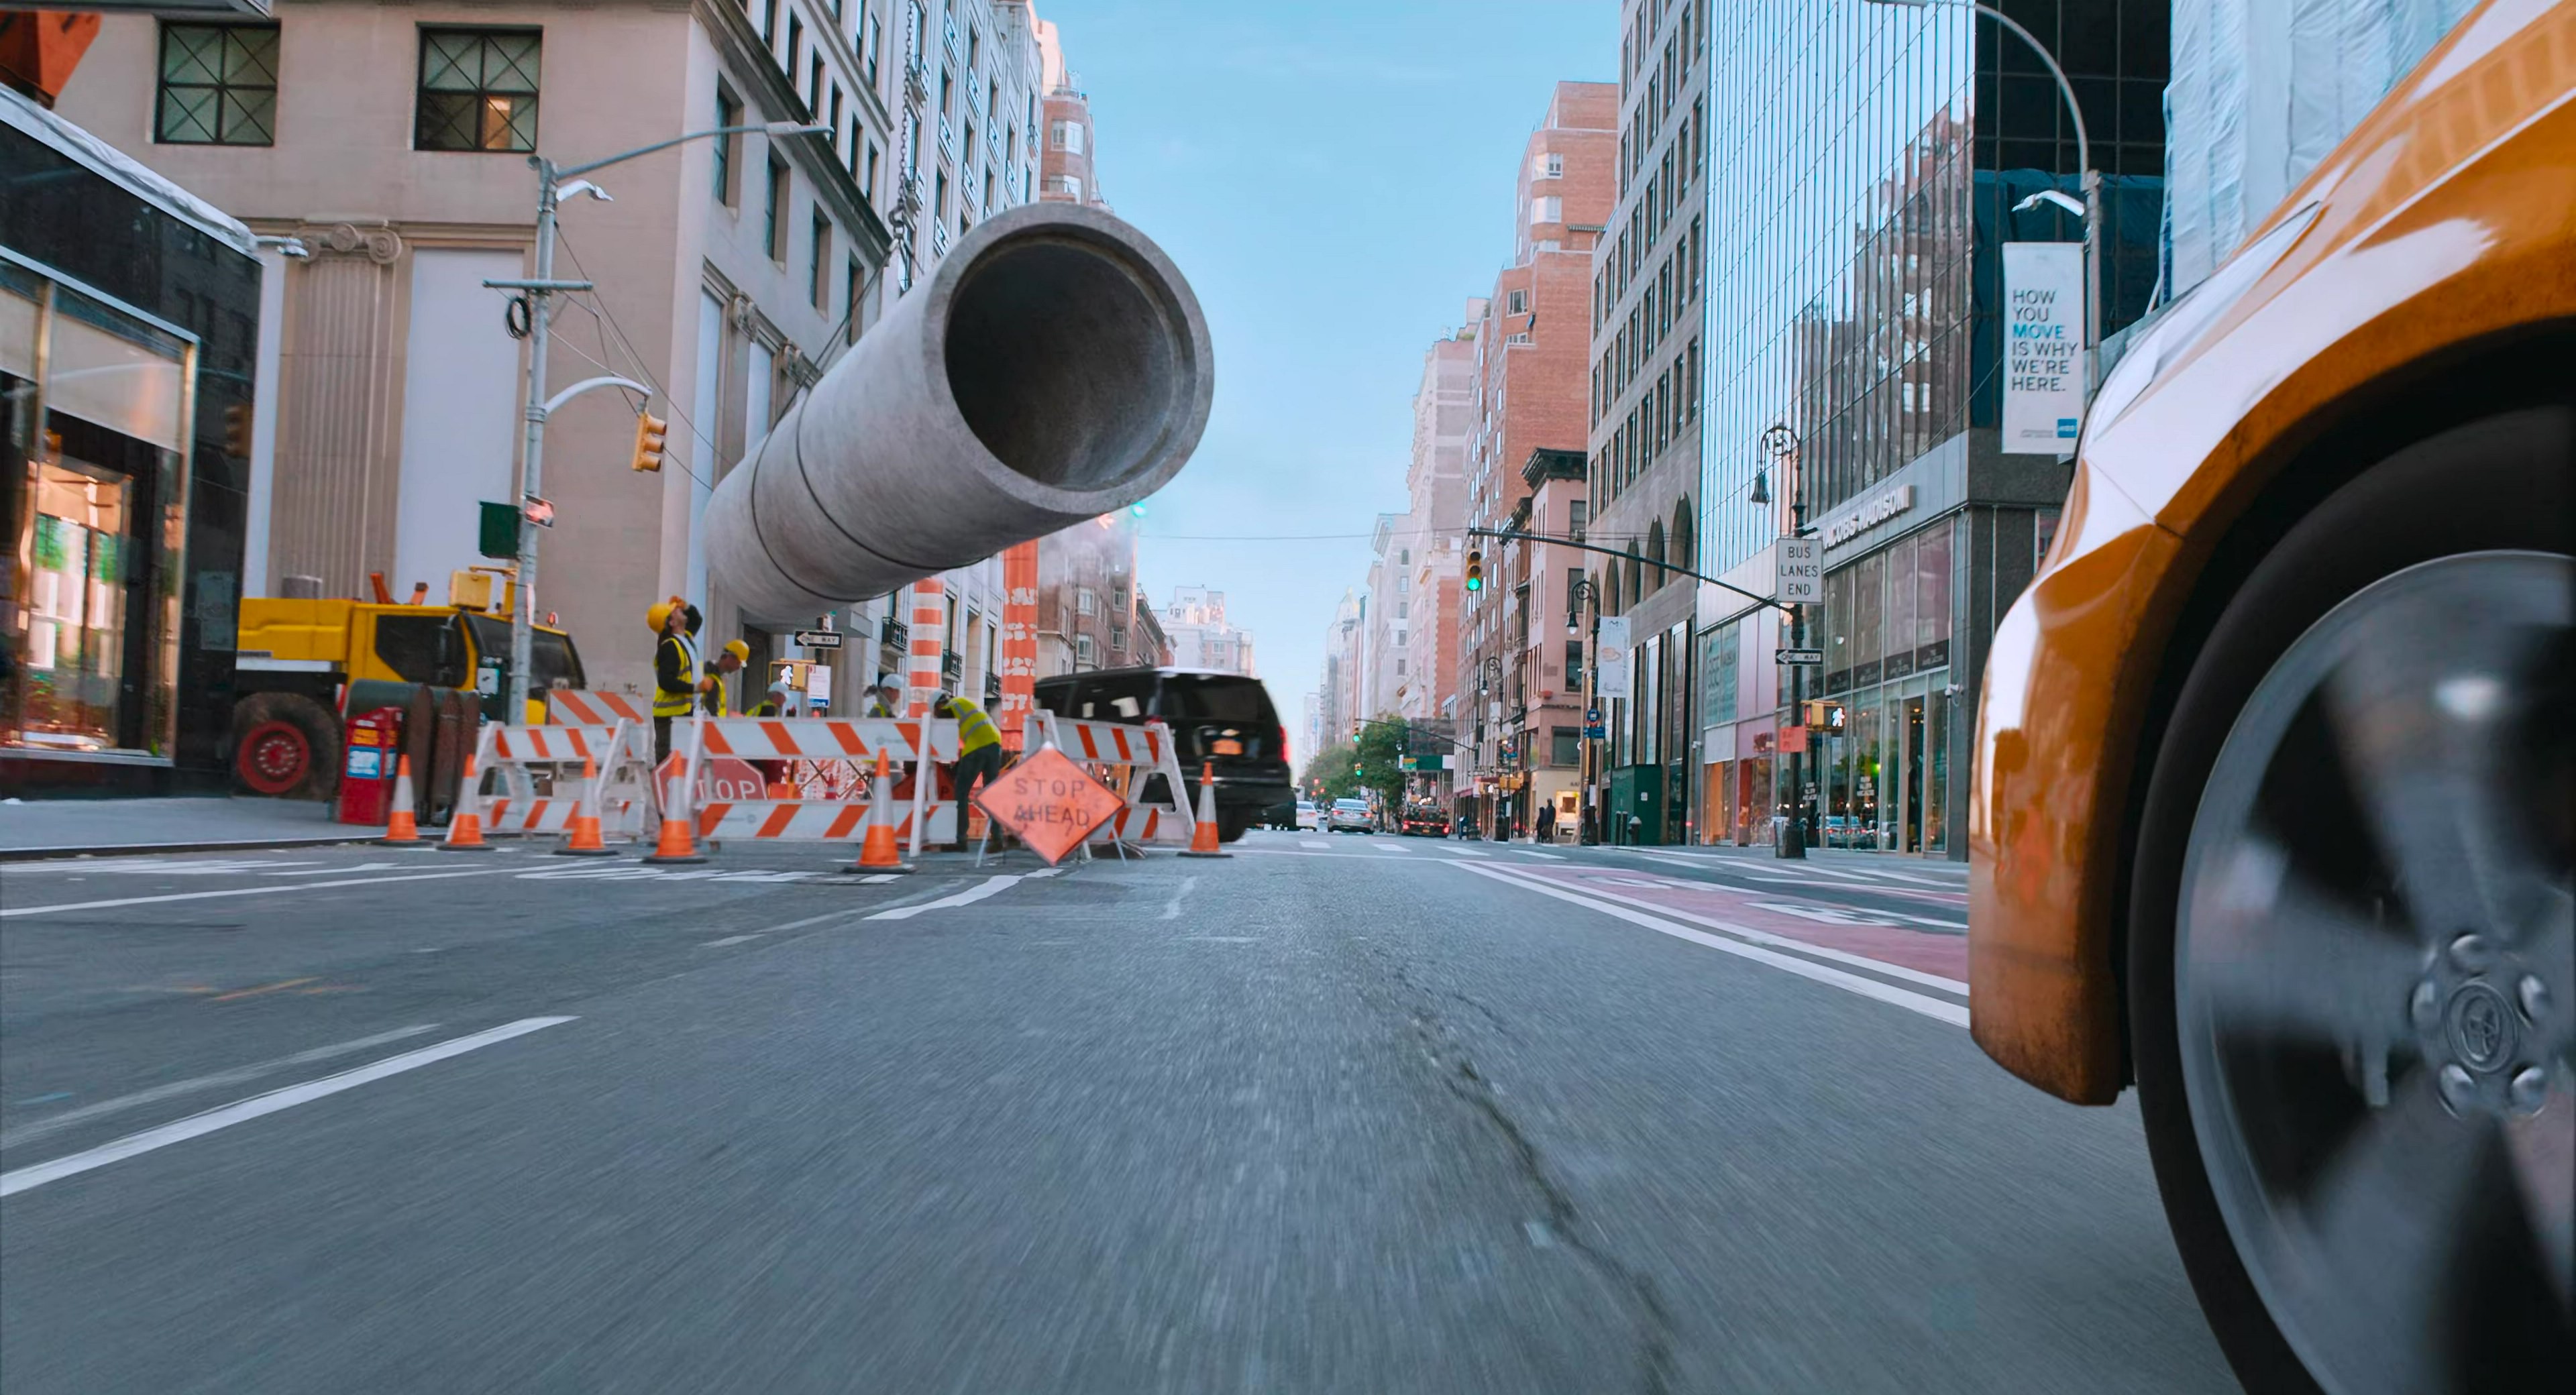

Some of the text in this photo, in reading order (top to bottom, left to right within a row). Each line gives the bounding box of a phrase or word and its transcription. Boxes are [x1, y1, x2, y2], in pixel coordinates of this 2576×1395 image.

[2012, 289, 2057, 304] HOW
[2012, 306, 2049, 322] YOU
[2012, 324, 2065, 339] MOVE
[2012, 341, 2078, 357] IS WHY
[2012, 359, 2070, 375] WE'RE
[2011, 376, 2066, 392] HERE.
[1788, 546, 1811, 559] BUS
[1780, 565, 1819, 577] LANES
[1788, 583, 1811, 596] END
[668, 779, 756, 799] TOP
[1014, 777, 1085, 798] STOP
[1013, 803, 1090, 827] AHEAD
